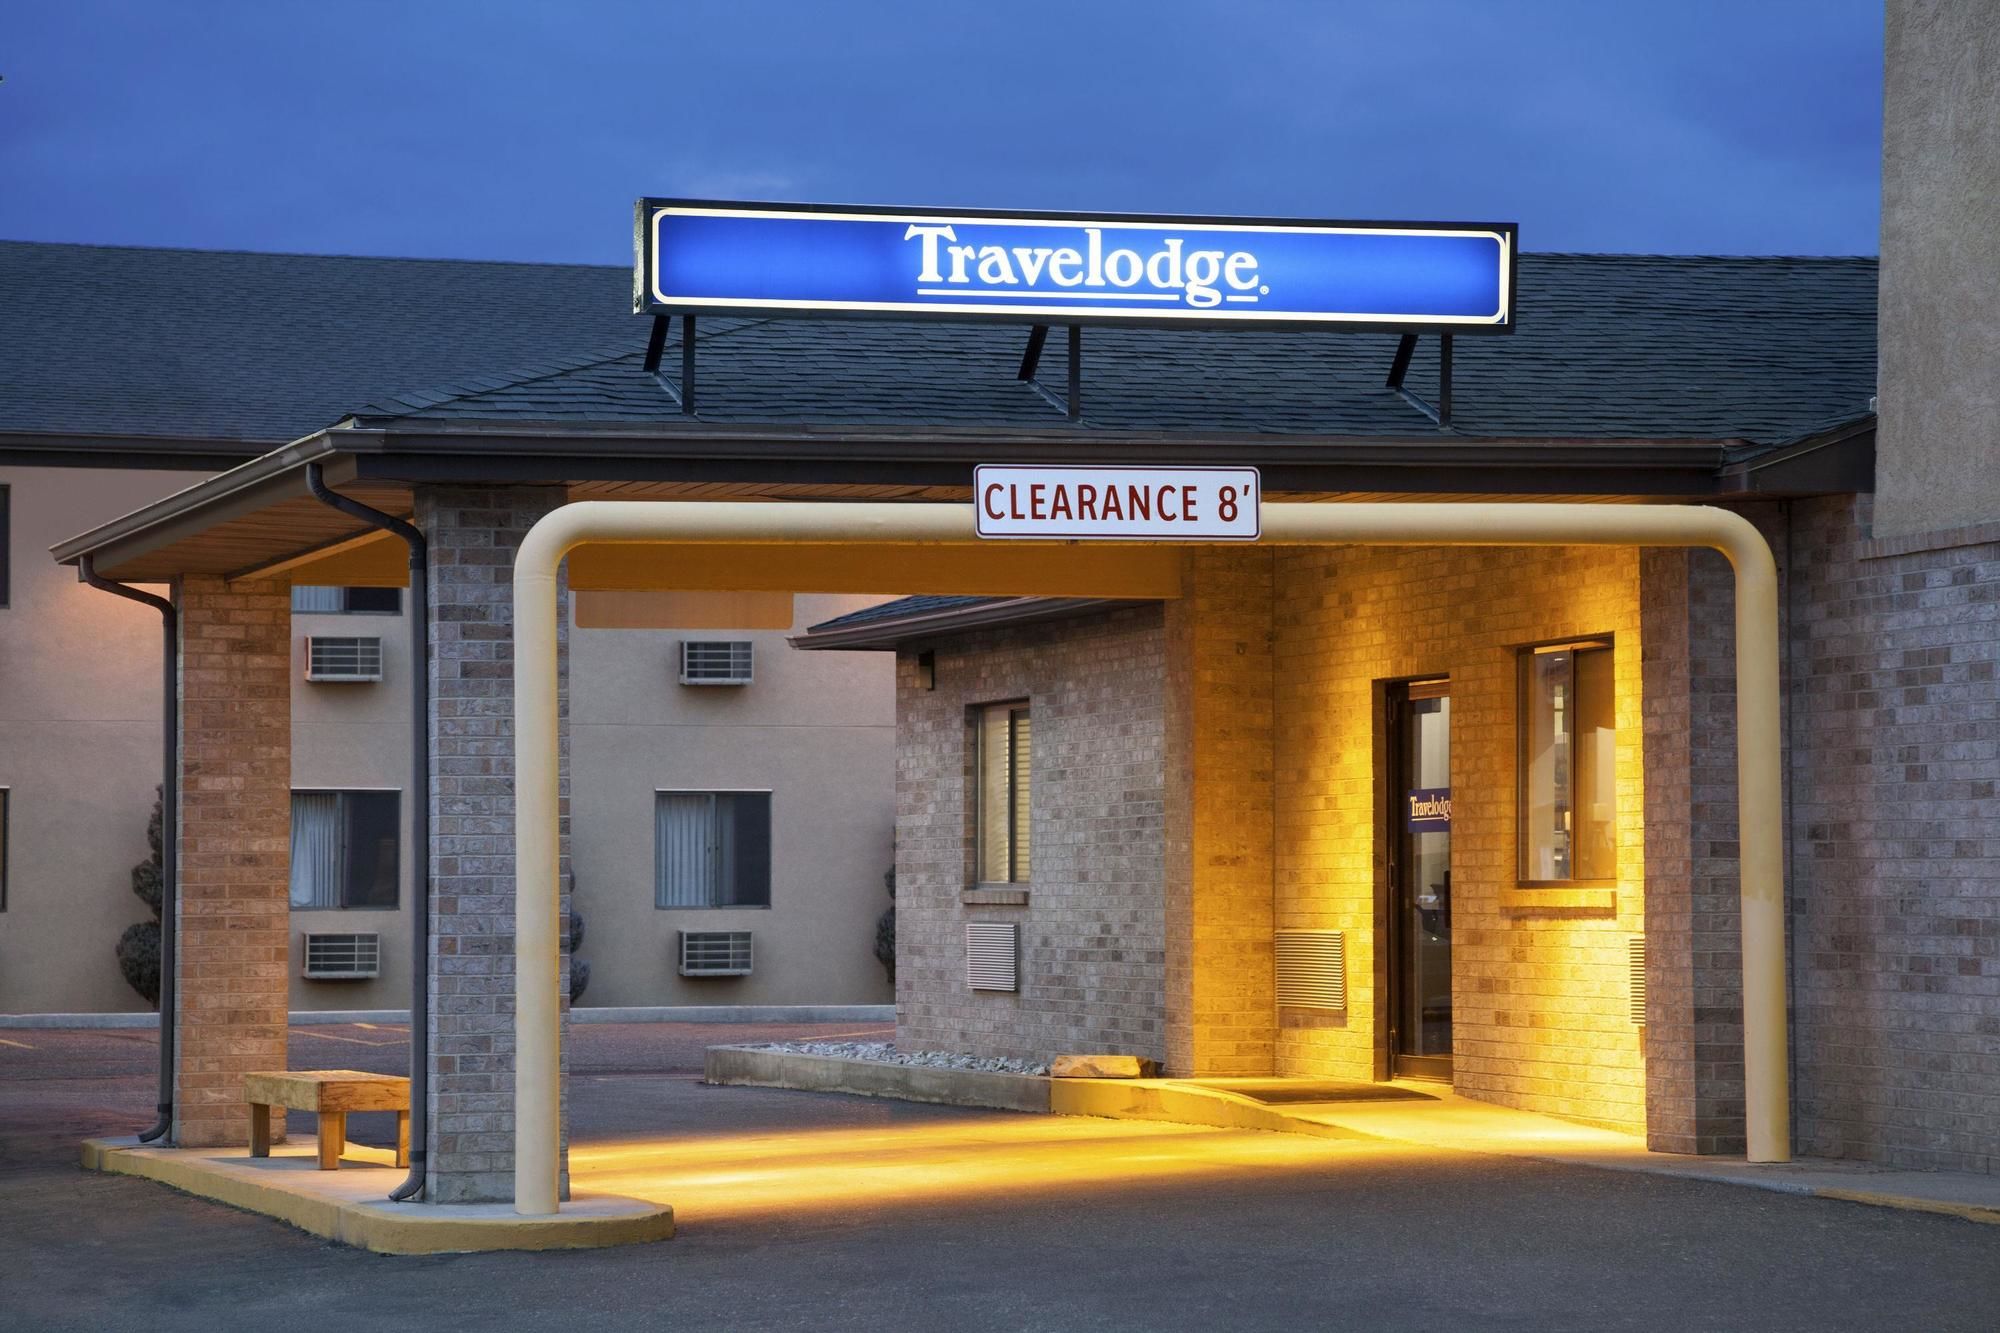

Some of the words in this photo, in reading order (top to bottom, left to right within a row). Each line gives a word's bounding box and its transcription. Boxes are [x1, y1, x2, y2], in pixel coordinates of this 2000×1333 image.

[904, 224, 1259, 308] Travelodge
[984, 483, 1198, 522] CLEARANCE
[1218, 484, 1250, 522] 8'
